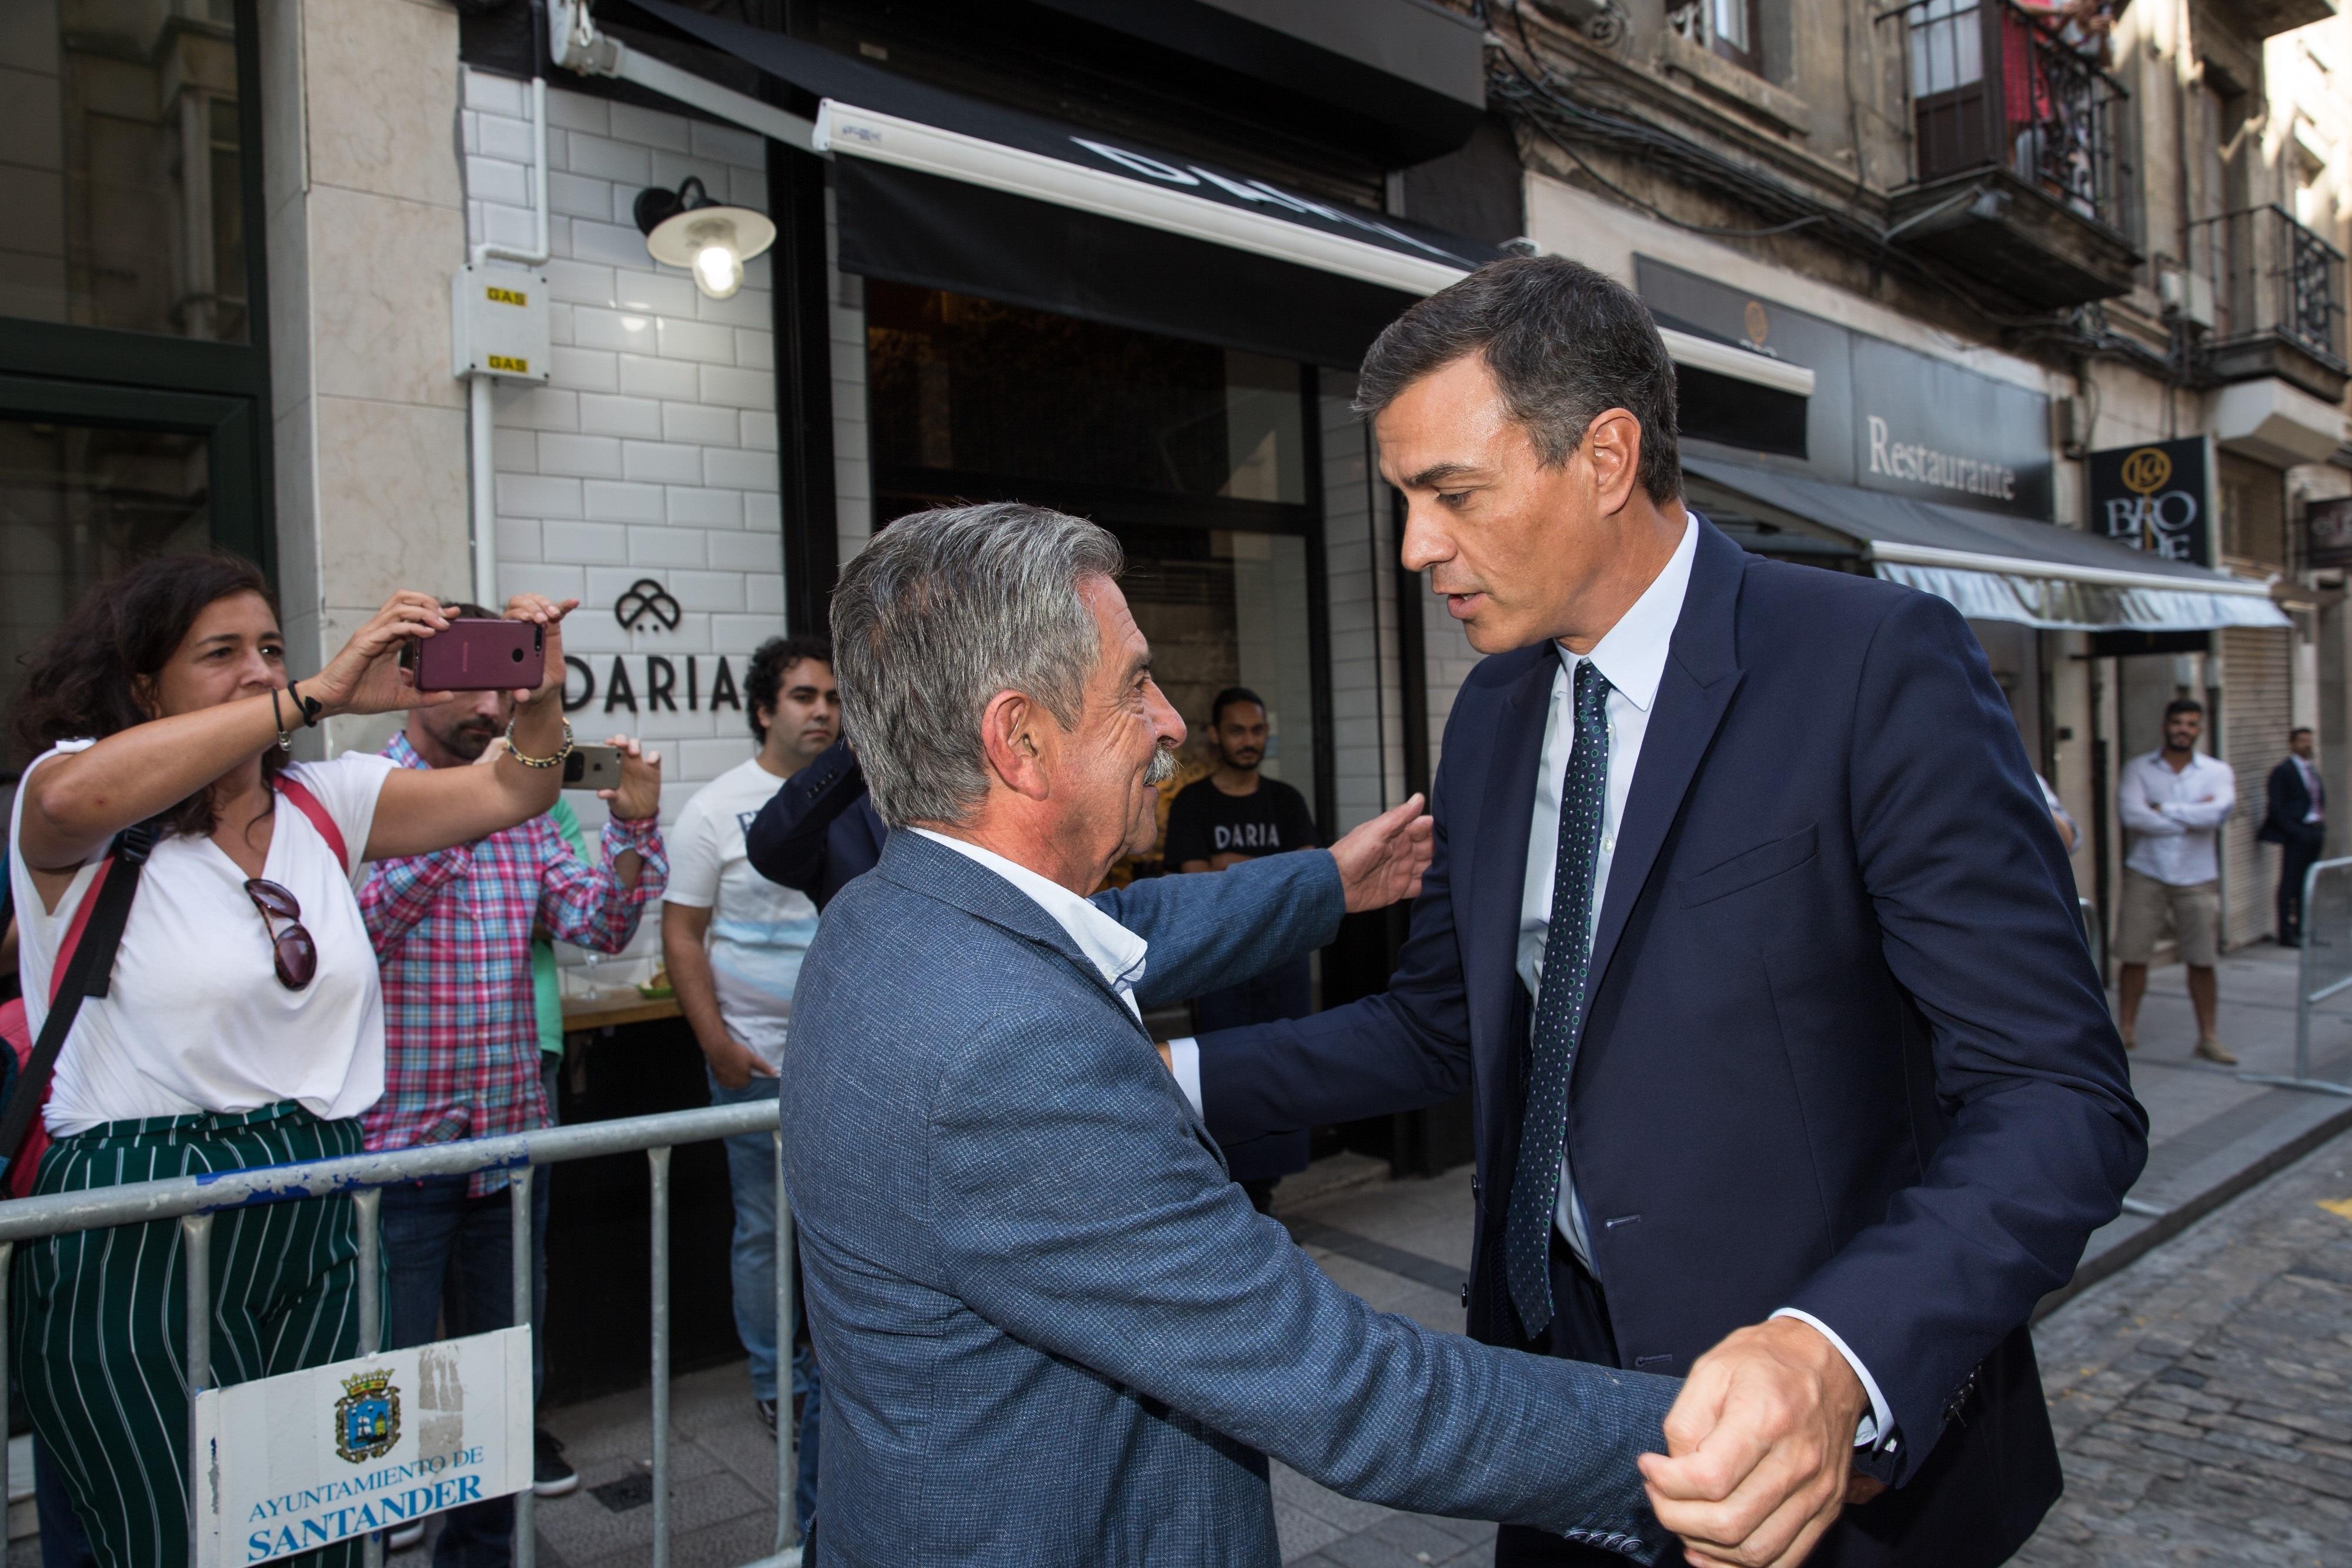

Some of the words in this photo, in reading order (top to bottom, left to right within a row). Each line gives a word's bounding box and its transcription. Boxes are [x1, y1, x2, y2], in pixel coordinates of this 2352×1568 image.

[487, 286, 527, 306] GAS
[489, 355, 528, 373] GAS
[1866, 414, 2015, 501] Restaurante
[2104, 490, 2197, 539] BRO
[560, 654, 741, 713] DARIA
[1214, 823, 1280, 850] DARIA
[248, 1455, 447, 1522] AYUNTAMIENTO
[452, 1446, 485, 1469] DE
[248, 1474, 483, 1563] SANTANDER
